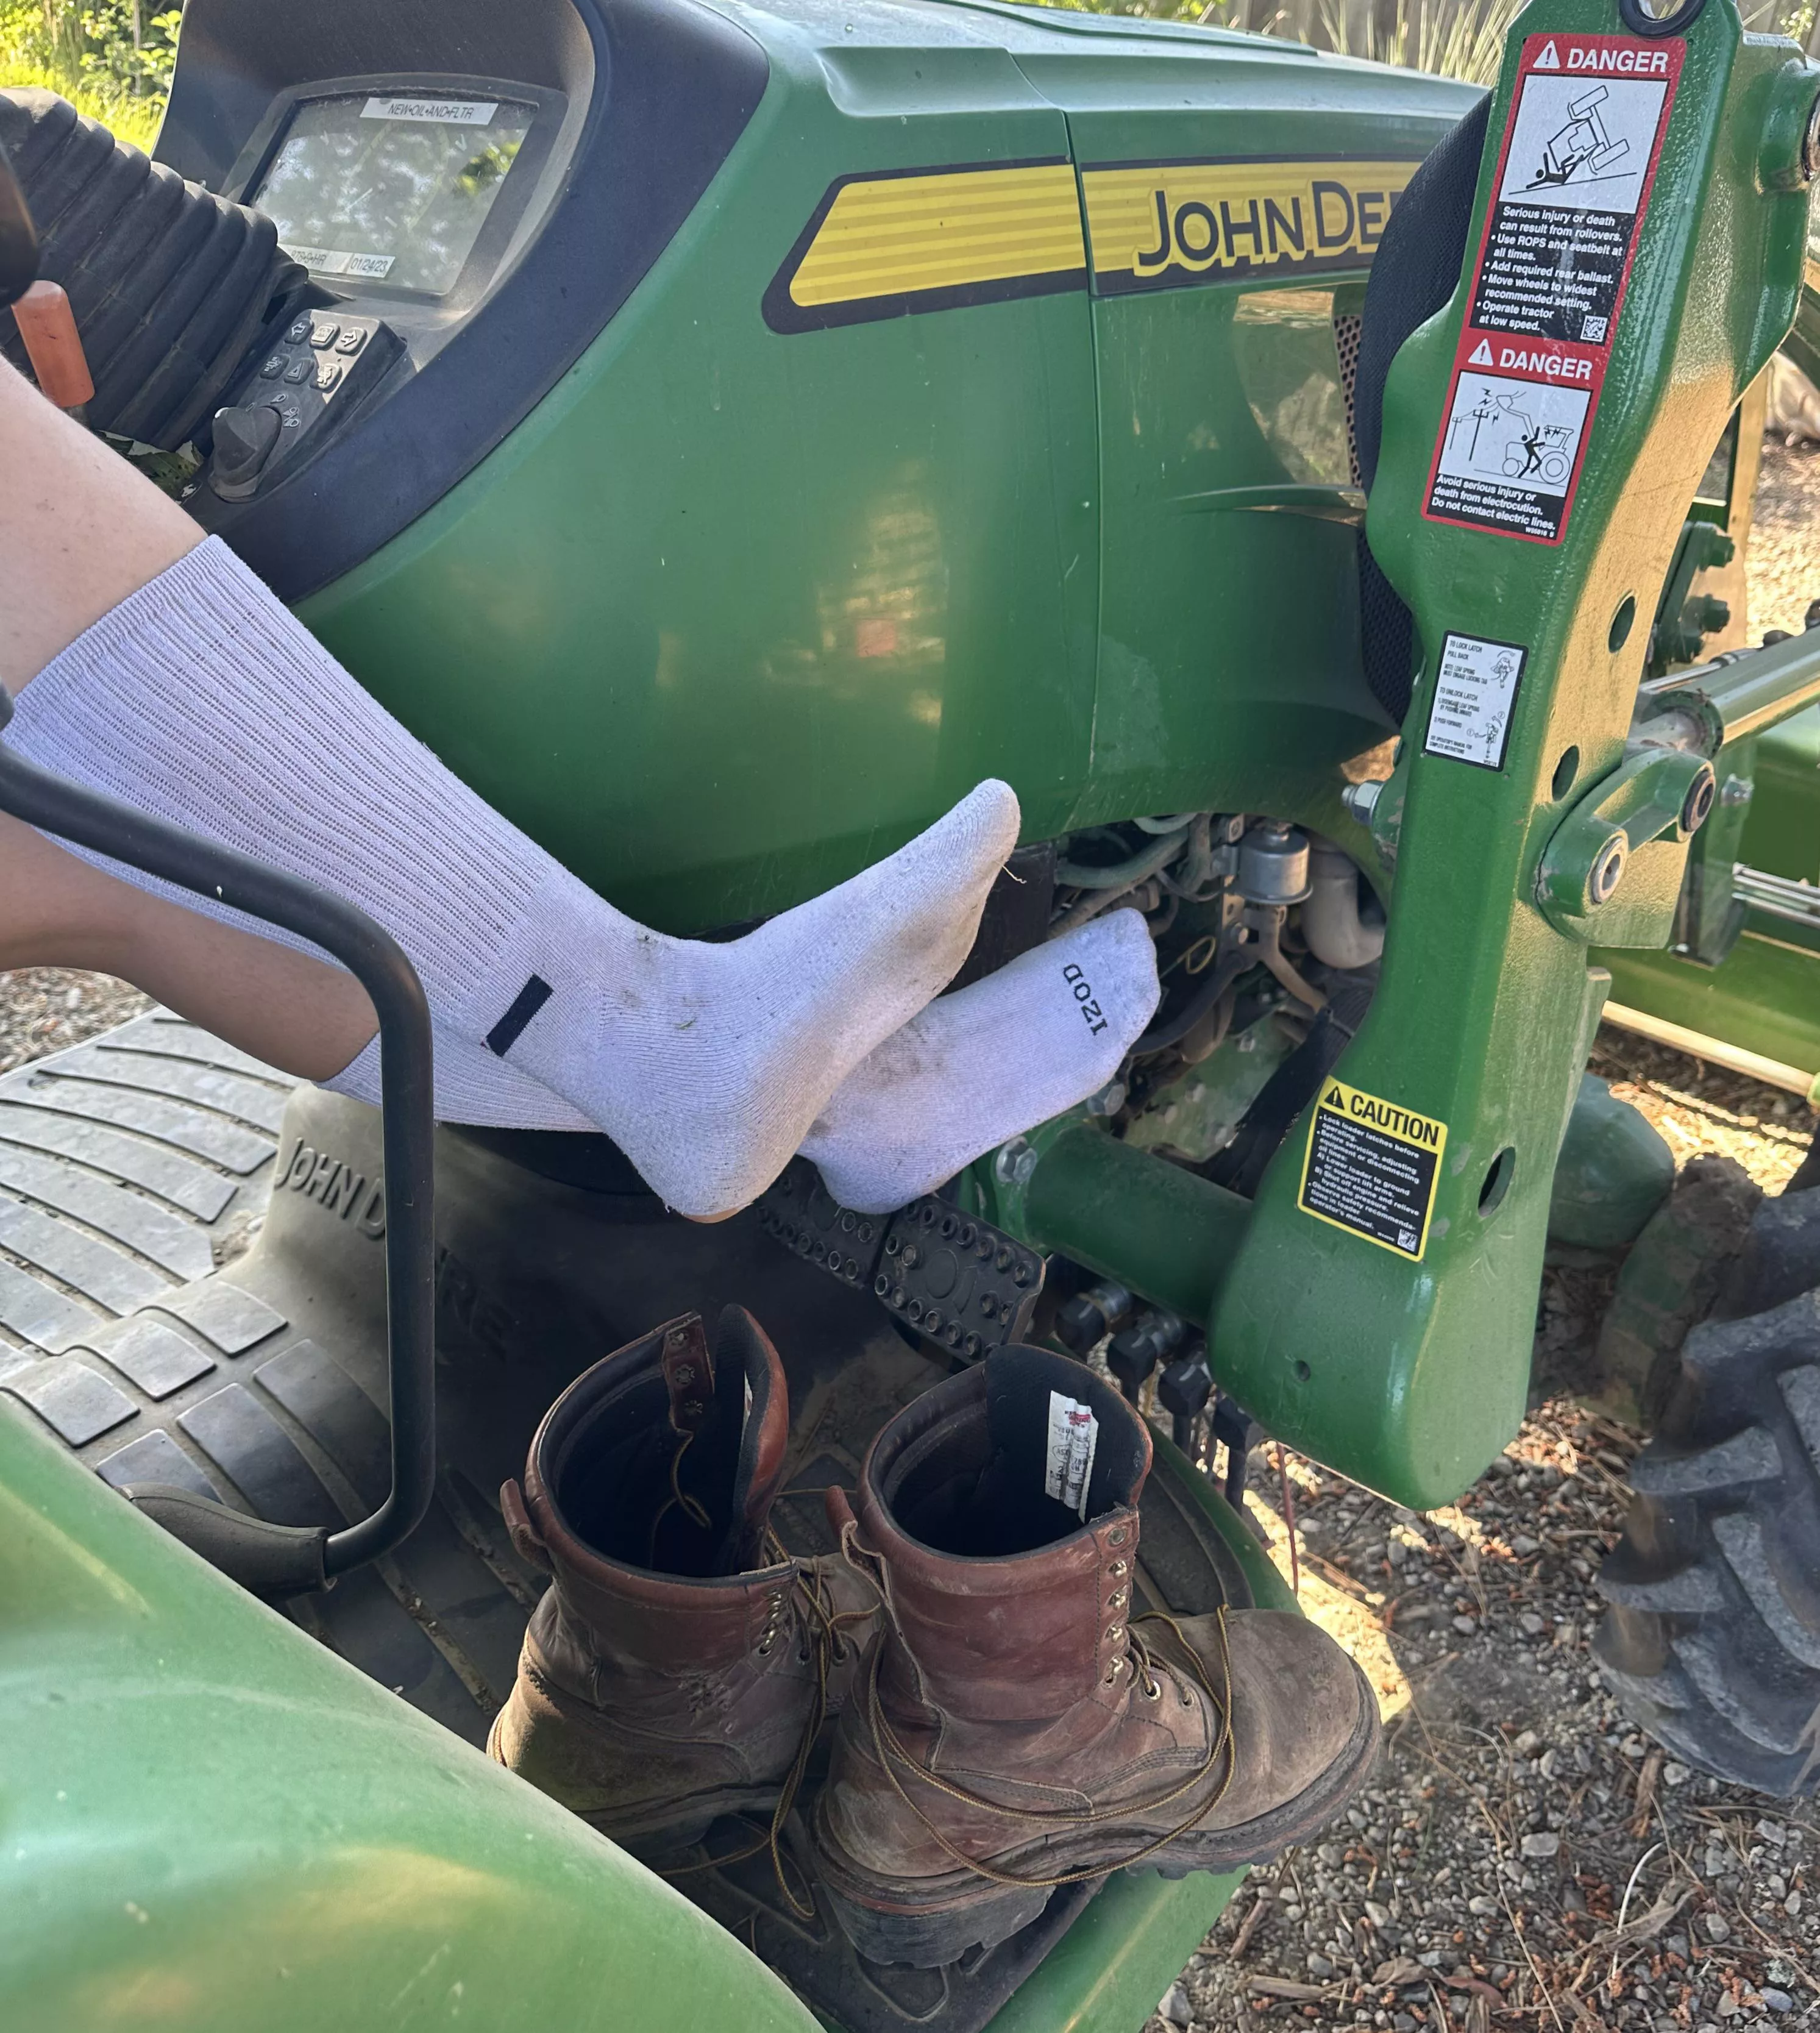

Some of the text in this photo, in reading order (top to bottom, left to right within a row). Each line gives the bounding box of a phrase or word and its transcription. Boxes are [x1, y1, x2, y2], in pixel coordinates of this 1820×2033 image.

[1567, 48, 1668, 73] DANGER
[1137, 190, 1305, 267] JOHN
[1503, 206, 1615, 226] Serious injury or death
[1497, 233, 1623, 256] Use ROPS and seatbelt at
[1500, 221, 1623, 241] can result from rollovers.
[350, 257, 388, 272] 01/24/23
[1493, 247, 1536, 261] all times.
[1488, 274, 1597, 296] Move wheels to widest
[1490, 260, 1613, 284] Add required rear ballast.
[1482, 301, 1555, 319] Operate tractor
[1485, 288, 1592, 312] recommended setting.
[1479, 314, 1540, 331] at low speed.
[1499, 348, 1593, 380] DANGER
[1434, 486, 1543, 515] death from electrocution.
[1437, 474, 1536, 502] Avoid serious injury or
[1432, 497, 1555, 530] Do not contact electric lines.
[1063, 963, 1107, 1036] IZOD
[1322, 1123, 1357, 1142] operating.
[1350, 1094, 1439, 1147] CAUTION
[1323, 1114, 1420, 1159] Lock loader latches before
[1320, 1138, 1356, 1158] equipment
[1367, 1158, 1420, 1185] disconnecting
[1321, 1129, 1343, 1144] Before
[1382, 1156, 1418, 1175] adjusting
[274, 1137, 364, 1220] JOHN
[1326, 1156, 1348, 1169] Lower
[1349, 1166, 1372, 1180] loader
[1373, 1176, 1382, 1184] to
[1383, 1181, 1410, 1195] ground
[1333, 1167, 1361, 1184] support
[1362, 1179, 1373, 1189] lift
[1374, 1185, 1395, 1198] arms.
[1311, 1189, 1329, 1201] tions
[1337, 1200, 1360, 1215] loader
[1312, 1181, 1341, 1198] Observe
[1342, 1195, 1363, 1209] safety
[1321, 1177, 1388, 1212] hydraulic pressure.
[1324, 1172, 1340, 1182] Shut
[1353, 1185, 1377, 1198] engine
[1378, 1195, 1393, 1206] and
[1394, 1201, 1420, 1216] relieve
[1310, 1197, 1374, 1230] operator's manual.
